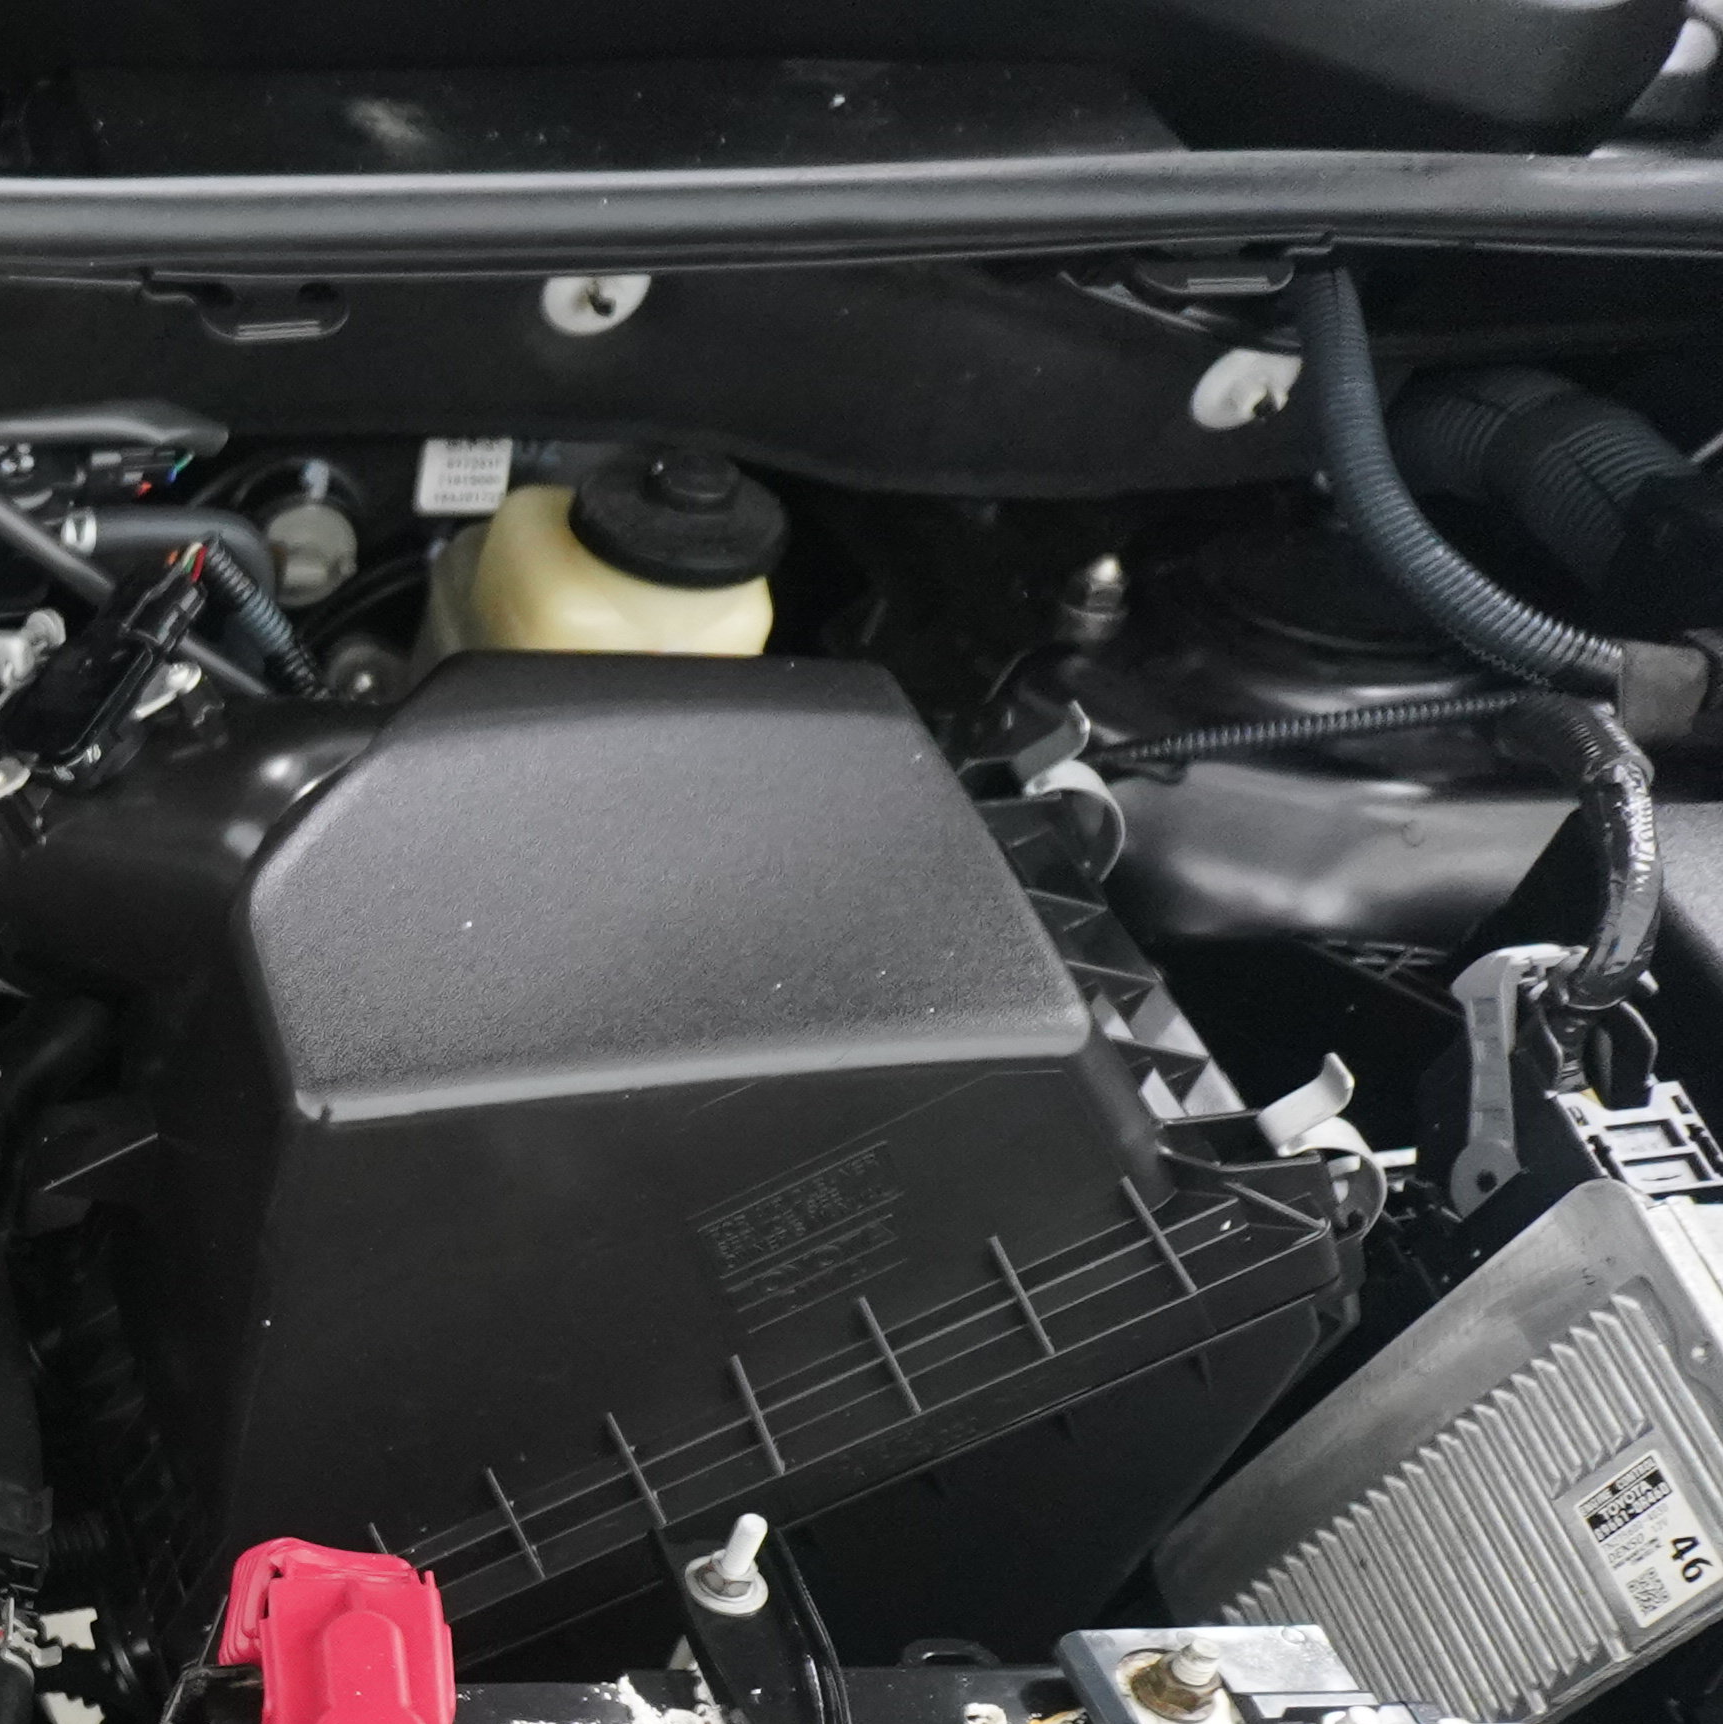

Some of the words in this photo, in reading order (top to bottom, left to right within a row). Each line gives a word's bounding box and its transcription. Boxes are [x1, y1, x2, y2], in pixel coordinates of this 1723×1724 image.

[1600, 1480, 1653, 1520] TOYOTA
[1608, 1532, 1645, 1563] DENSO
[1670, 1535, 1714, 1583] 46
